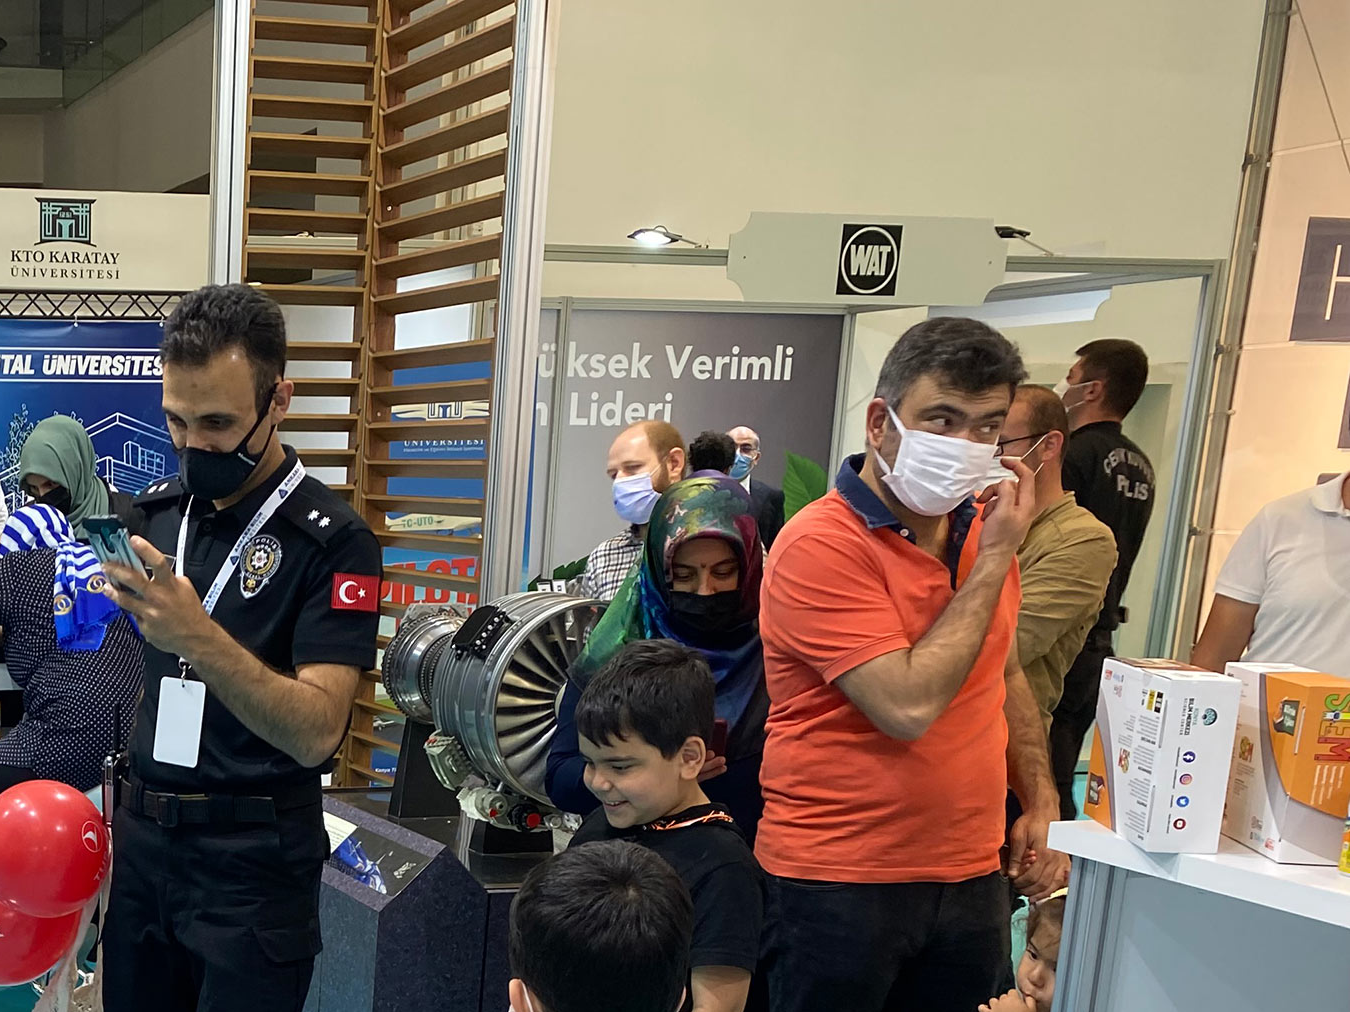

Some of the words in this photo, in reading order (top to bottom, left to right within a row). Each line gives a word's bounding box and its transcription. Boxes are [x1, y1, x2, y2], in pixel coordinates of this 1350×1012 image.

[11, 250, 45, 262] KTO
[49, 251, 120, 264] KARATAY
[850, 244, 892, 276] WAT
[11, 265, 120, 279] ÜNİVERSİTESİ
[665, 344, 794, 381] Verimli
[569, 390, 673, 426] Lideri
[1117, 474, 1149, 501] PLİS
